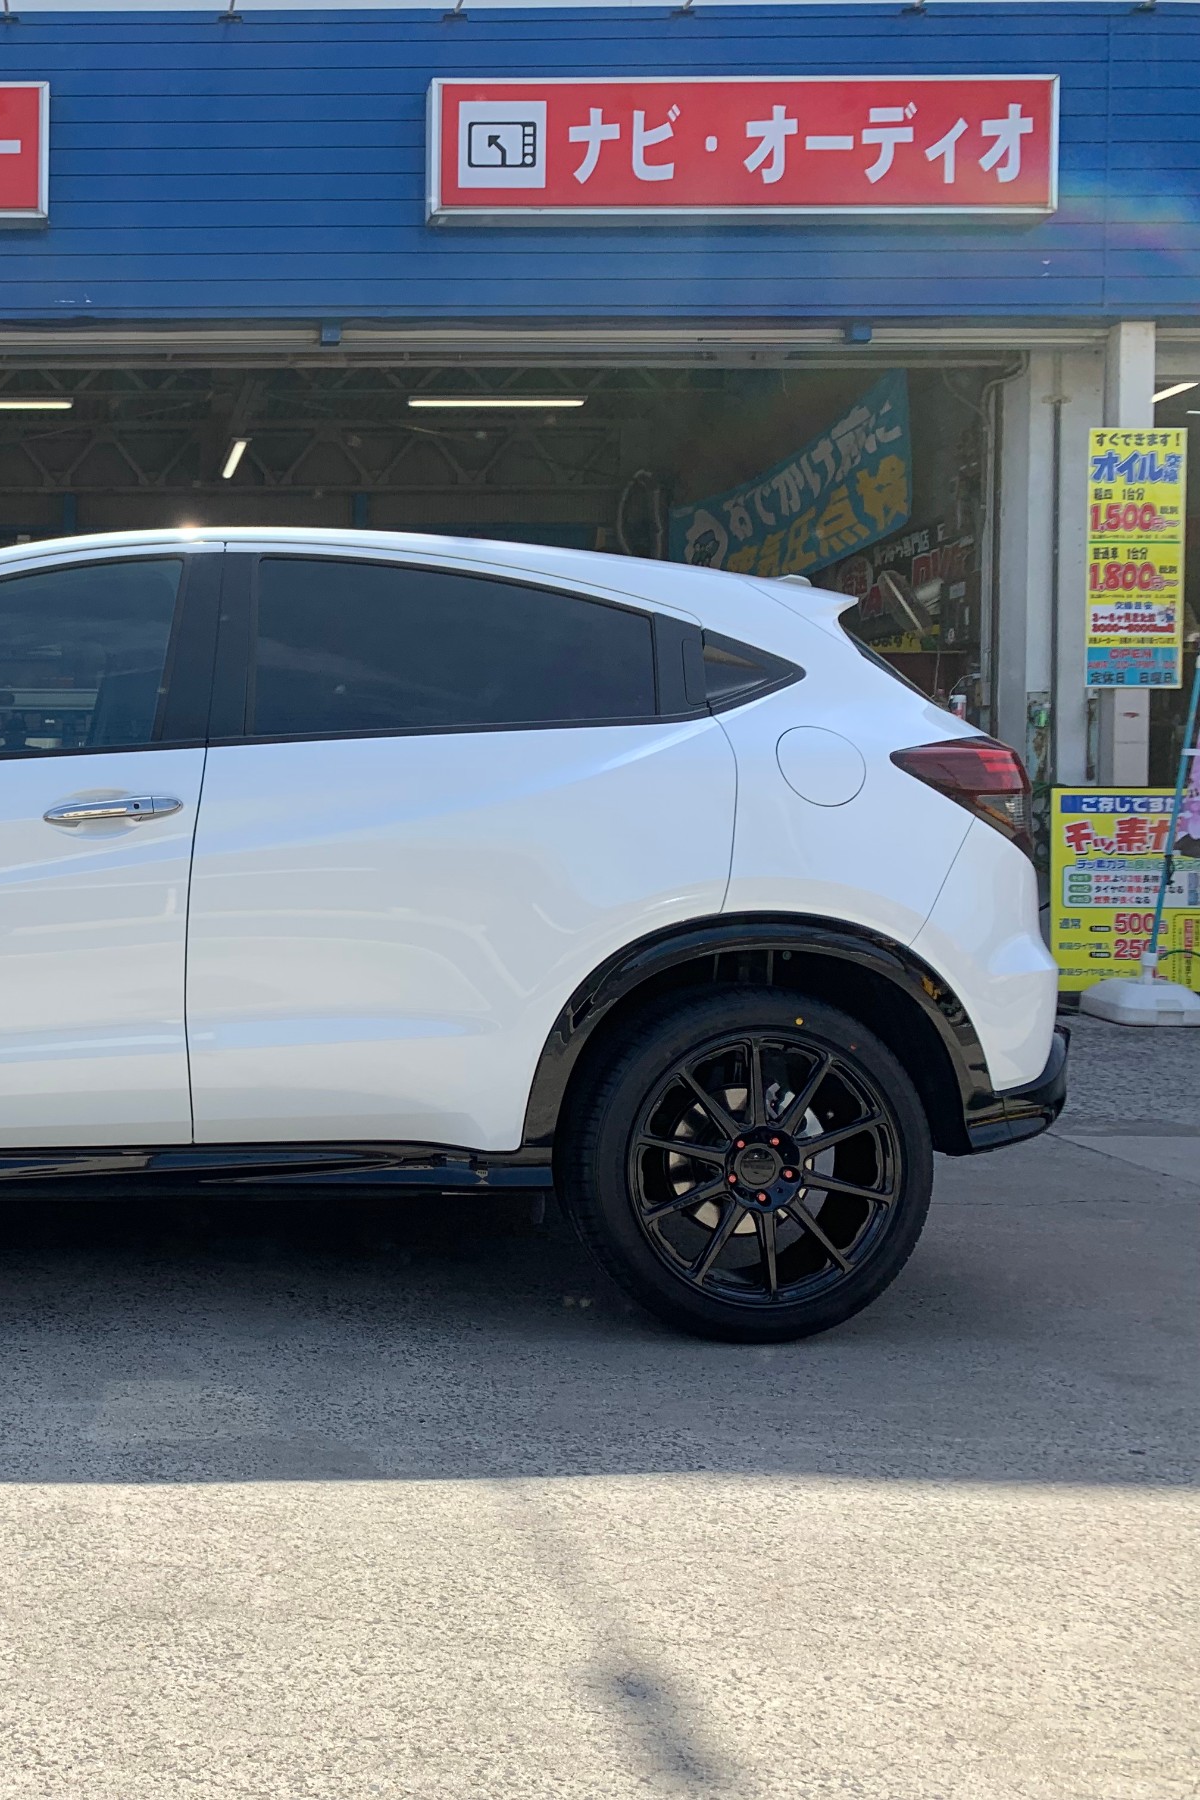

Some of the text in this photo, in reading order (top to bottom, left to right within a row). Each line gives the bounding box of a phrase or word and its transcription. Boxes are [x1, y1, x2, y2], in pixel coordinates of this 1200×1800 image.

[568, 101, 1034, 184] ナビ・オーディオ
[1110, 649, 1153, 659] OPEN
